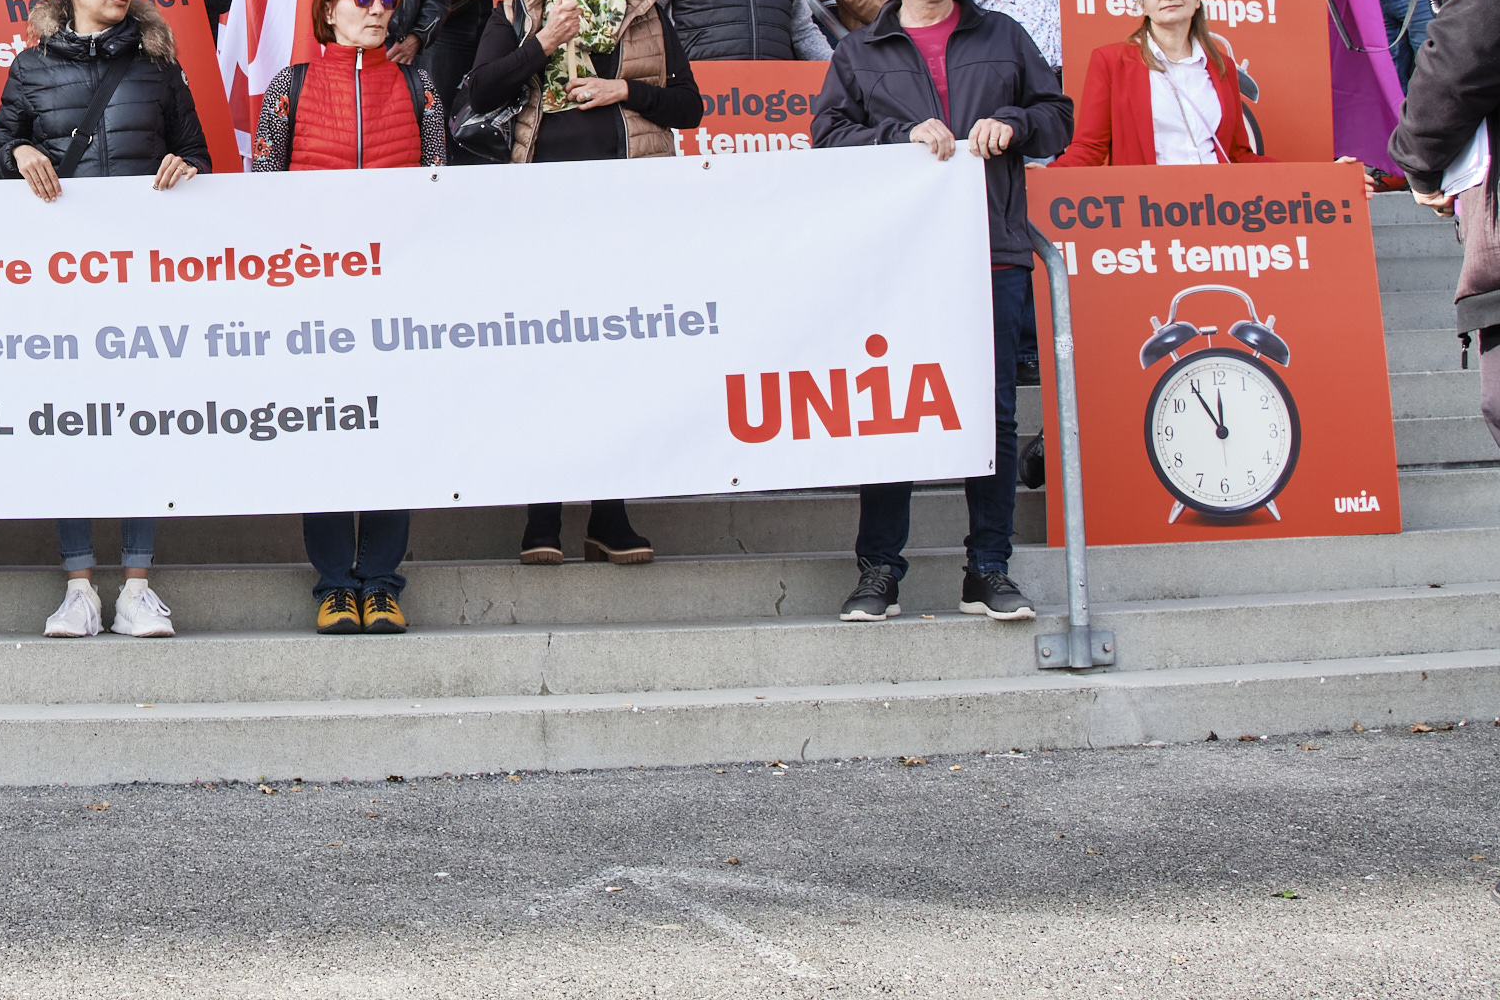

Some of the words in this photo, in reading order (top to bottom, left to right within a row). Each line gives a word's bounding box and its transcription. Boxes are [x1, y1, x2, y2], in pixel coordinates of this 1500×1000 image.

[695, 127, 811, 156] temps
[1049, 196, 1125, 230] CCT
[1140, 192, 1352, 233] horlogerie:
[1092, 240, 1157, 275] est
[1168, 236, 1309, 278] temps!
[47, 250, 134, 284] CCT
[150, 243, 382, 288] horlogère!
[95, 324, 190, 359] GAV
[205, 321, 270, 357] für
[285, 321, 356, 355] die
[371, 301, 719, 352] Uhrenindustrie!
[1212, 370, 1226, 386] 12
[1173, 398, 1186, 414] 10
[1260, 395, 1269, 410] 2
[28, 395, 381, 442] dell’orologeria!
[1164, 425, 1174, 441] 9
[1269, 423, 1278, 438] 3
[1174, 452, 1183, 468] 8
[1262, 450, 1272, 464] 4
[1195, 472, 1204, 488] 7
[1220, 478, 1229, 494] 6
[1247, 470, 1256, 486] 5
